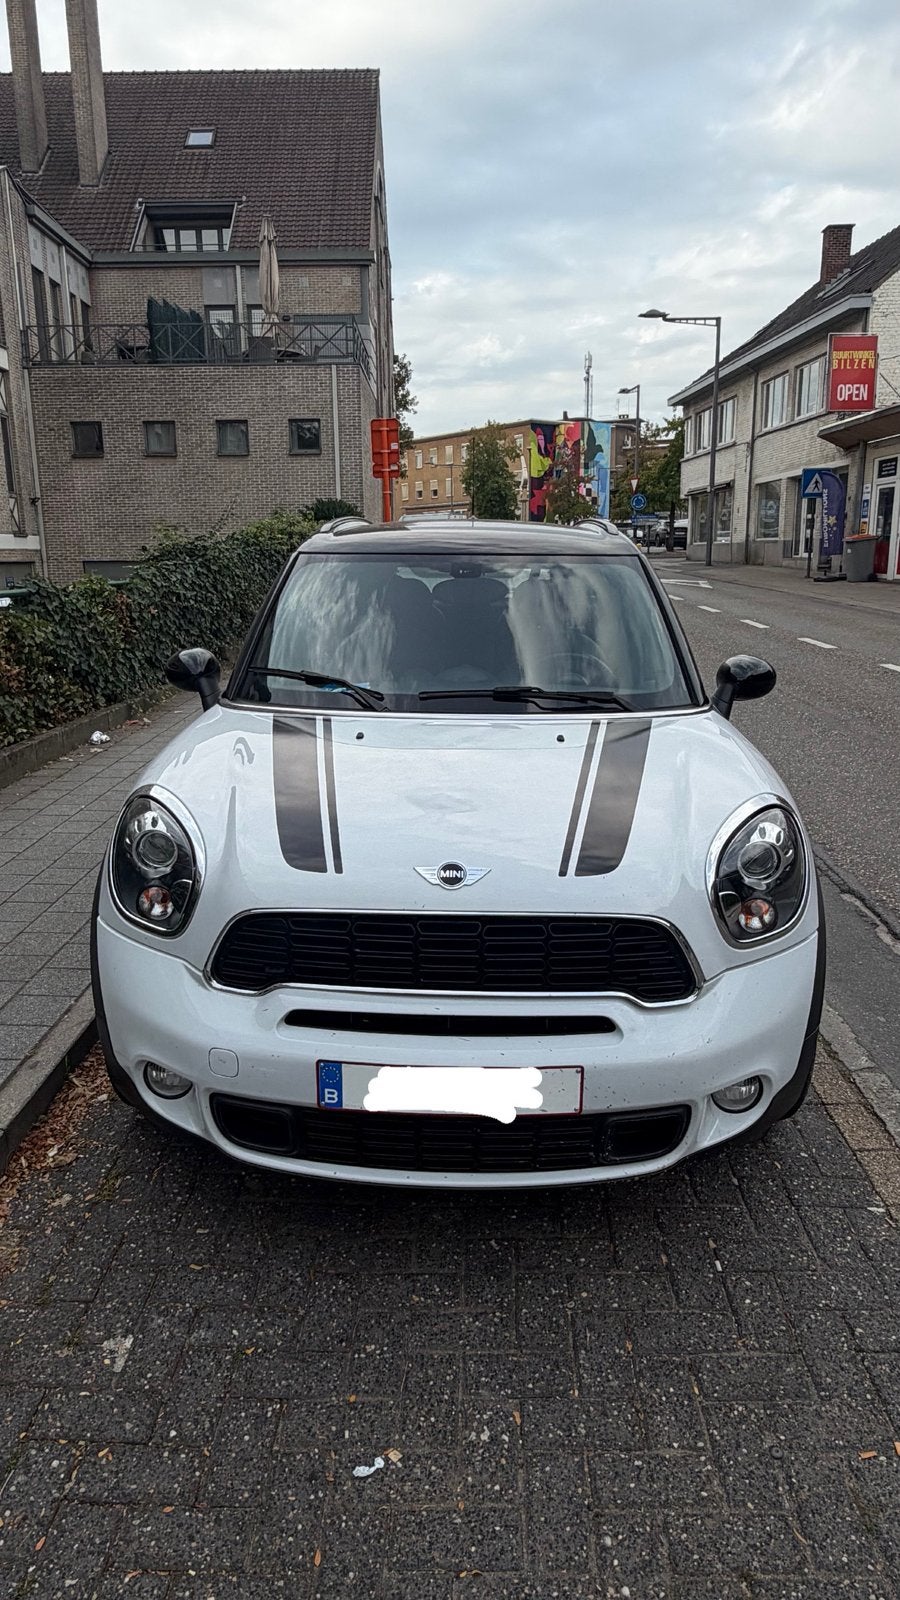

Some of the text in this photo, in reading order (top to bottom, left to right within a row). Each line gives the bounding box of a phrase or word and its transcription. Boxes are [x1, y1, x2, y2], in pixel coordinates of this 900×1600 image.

[832, 359, 875, 369] BILZEN
[837, 384, 868, 402] OPEN
[440, 870, 464, 878] MINI
[324, 1088, 338, 1103] B
